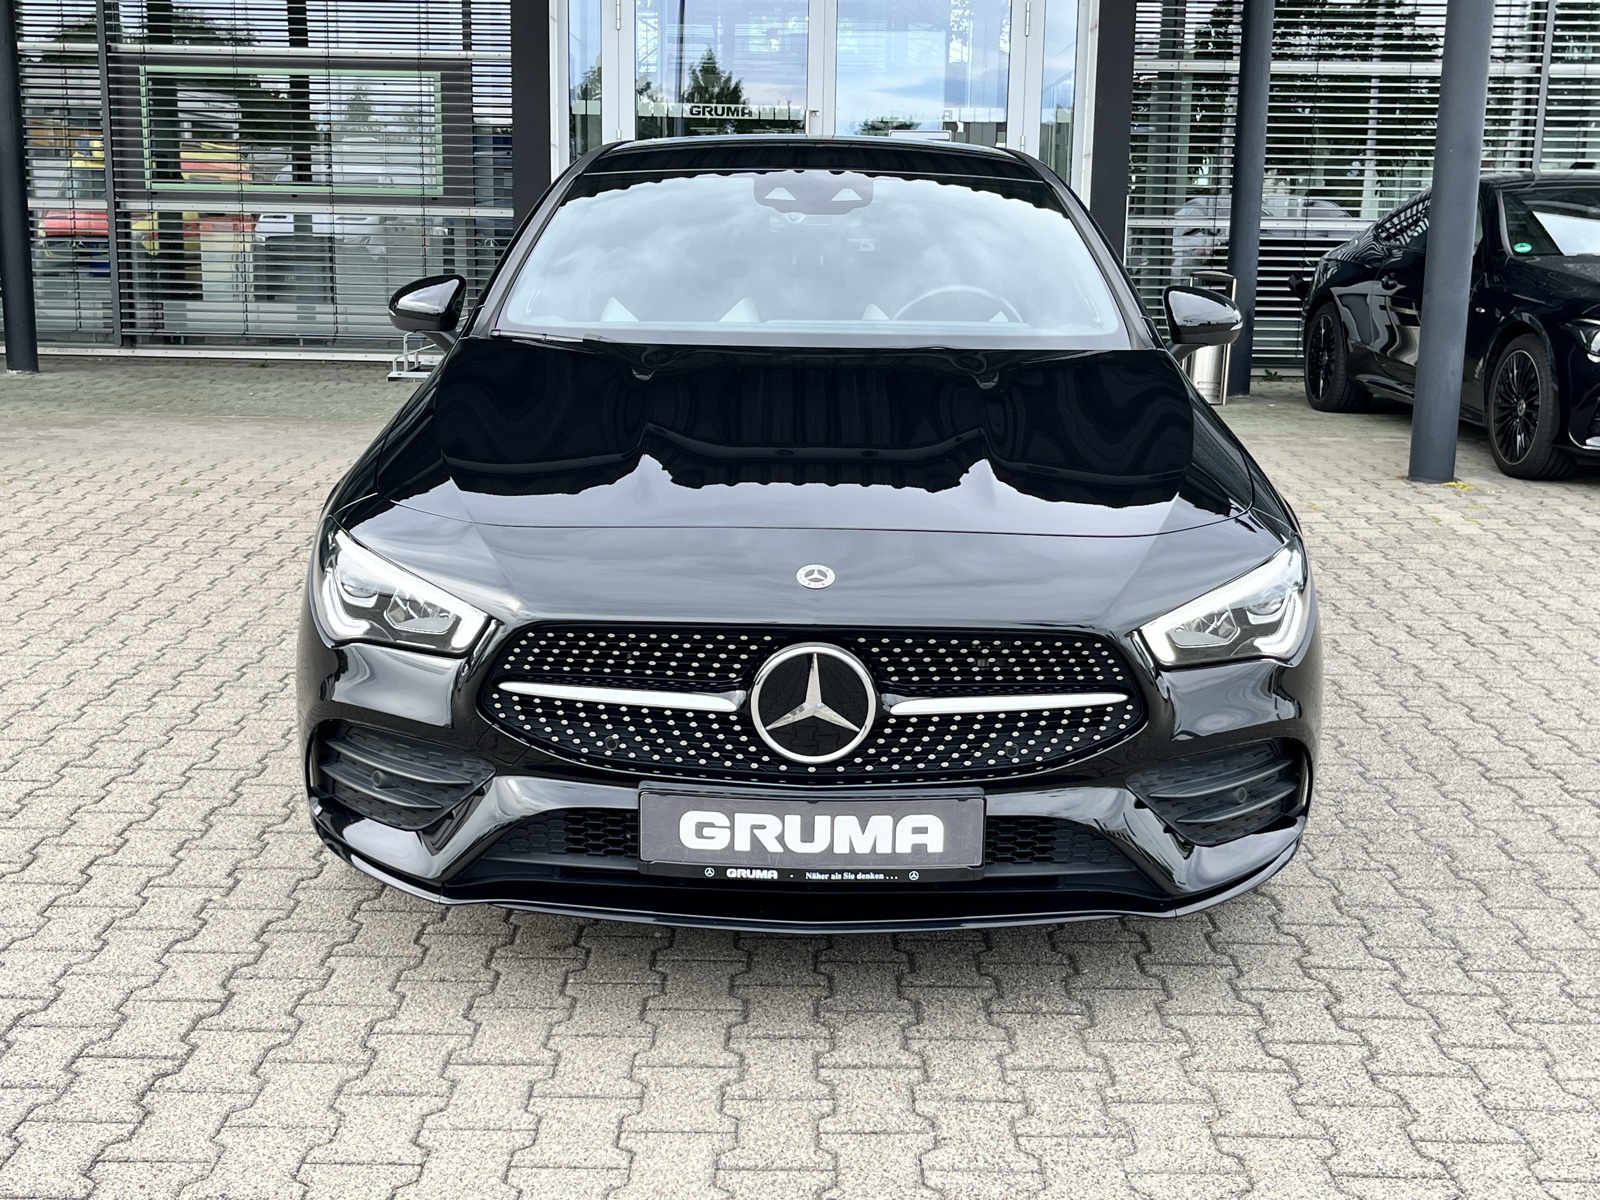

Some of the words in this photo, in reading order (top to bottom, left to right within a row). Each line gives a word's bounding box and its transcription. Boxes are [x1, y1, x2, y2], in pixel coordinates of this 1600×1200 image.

[689, 105, 753, 118] GRUMA
[679, 810, 945, 854] GRUMA
[726, 868, 778, 880] GRUMA
[805, 871, 829, 880] Näher
[831, 872, 841, 880] als
[843, 872, 855, 880] Sie
